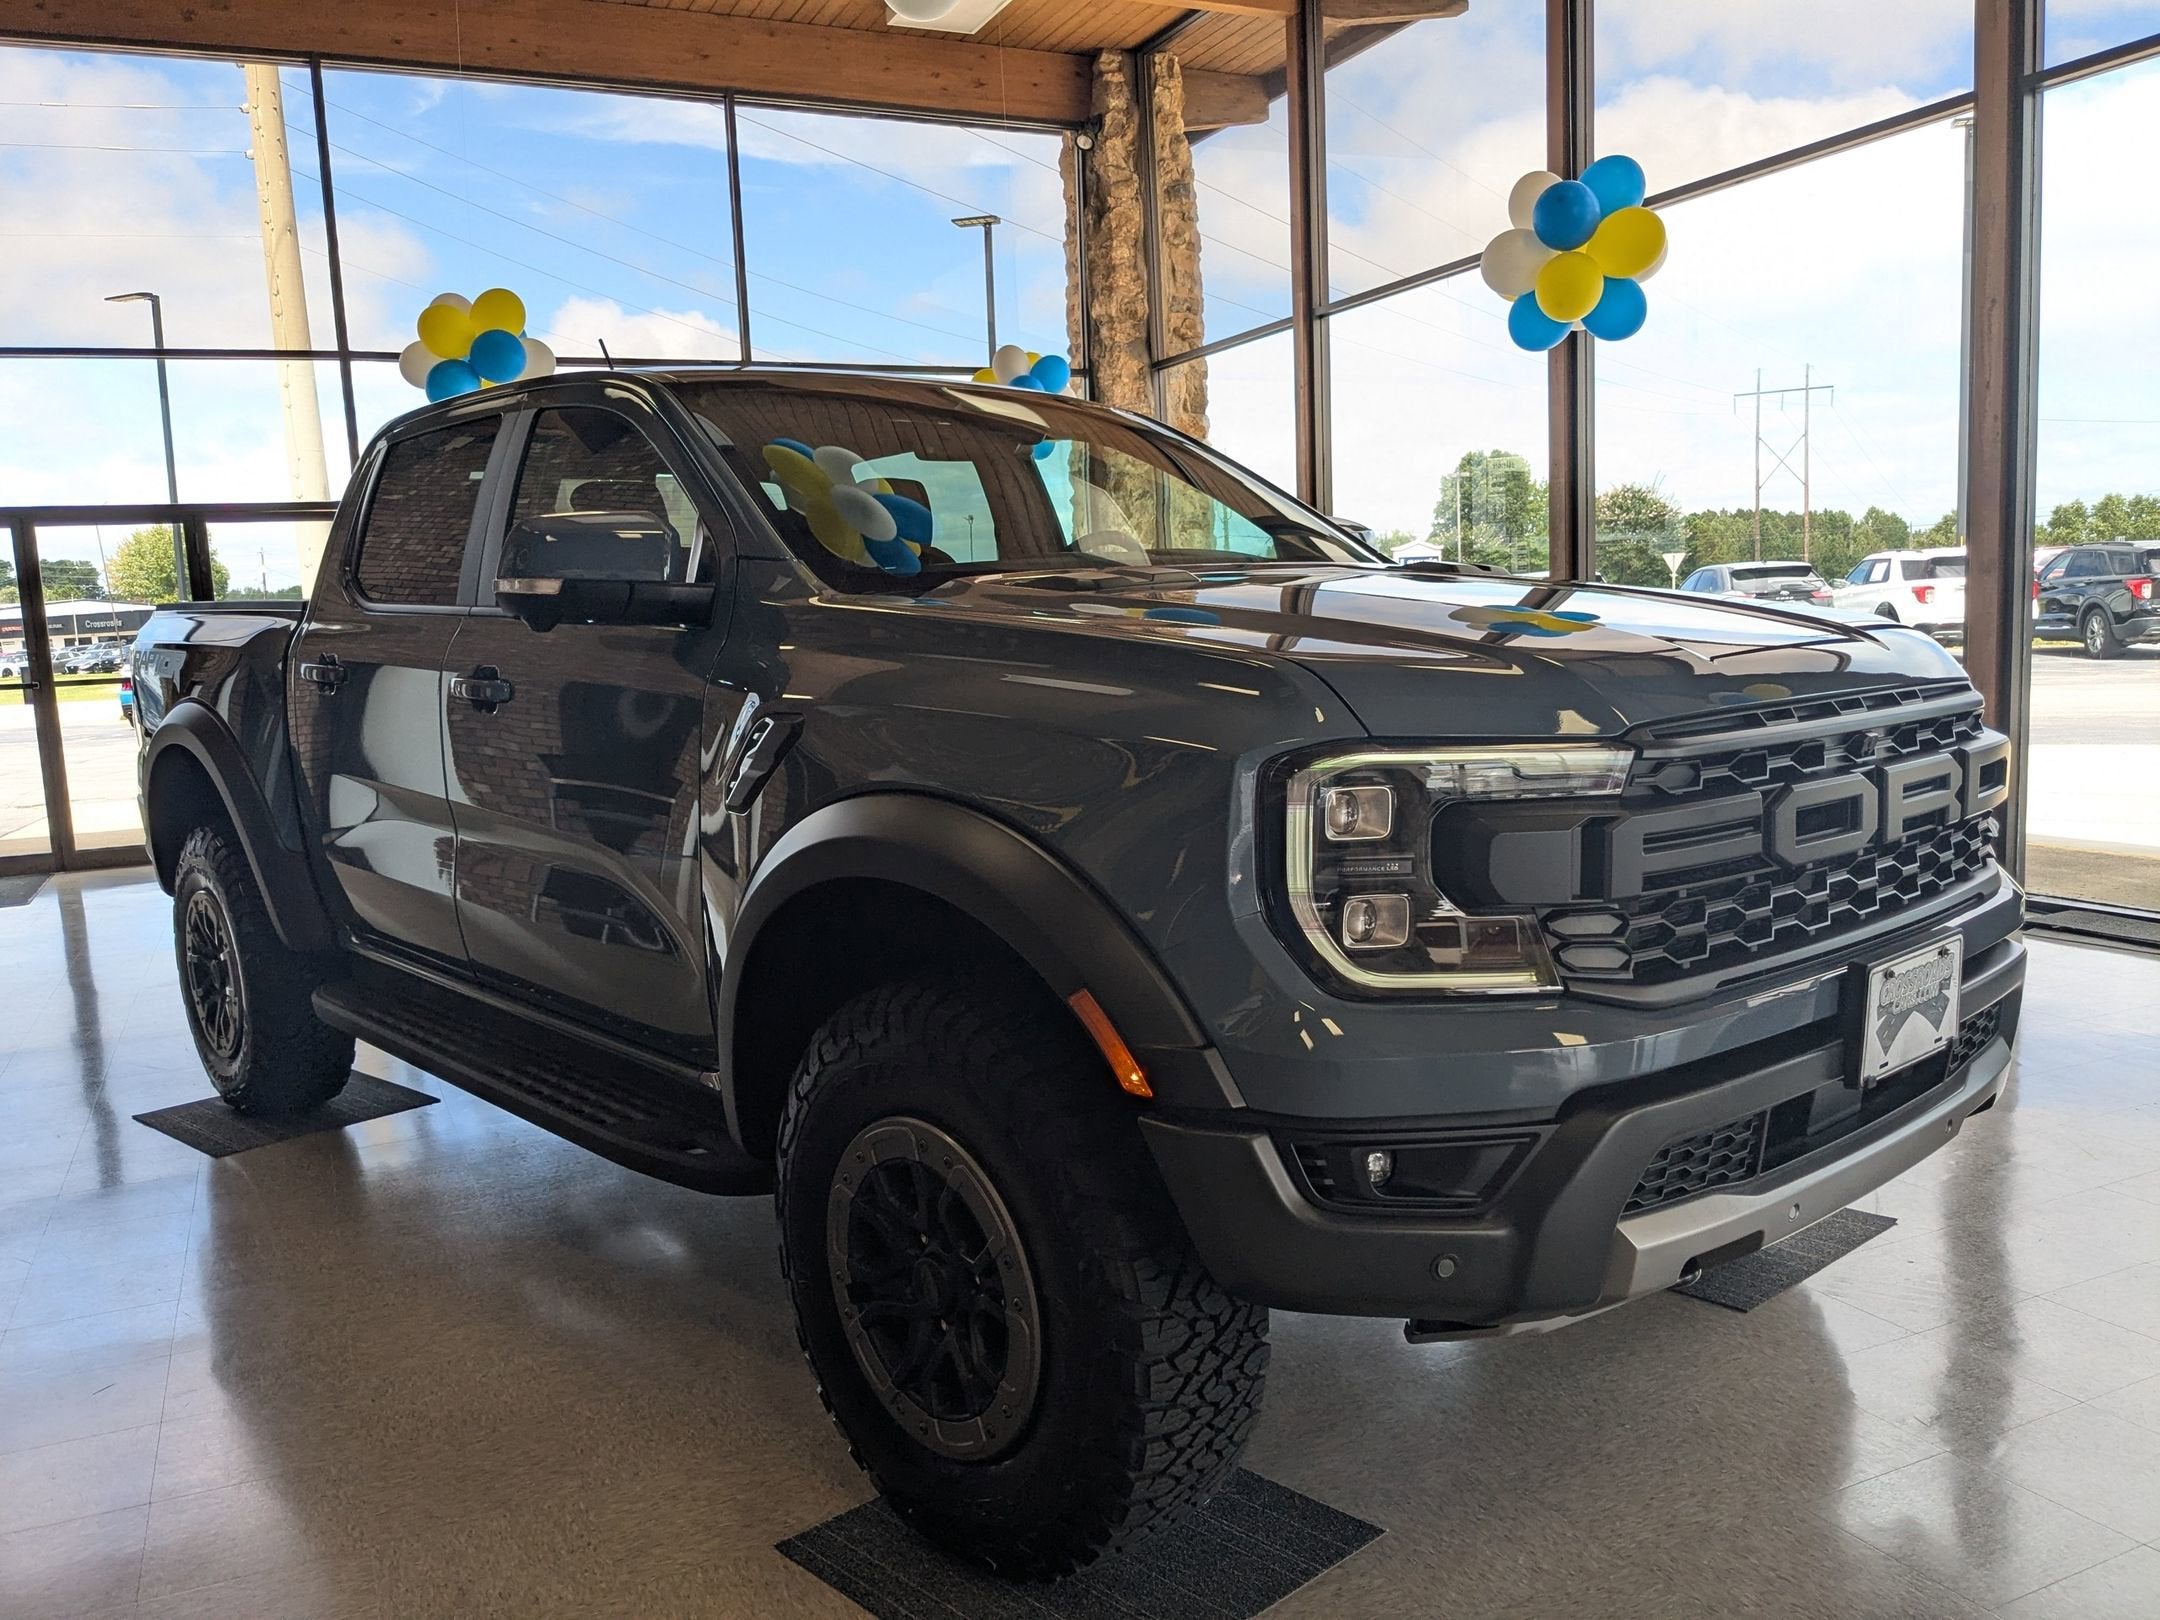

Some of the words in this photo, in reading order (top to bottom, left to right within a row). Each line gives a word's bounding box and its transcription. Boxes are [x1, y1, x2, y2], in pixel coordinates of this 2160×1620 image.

[85, 619, 122, 628] Crossroads
[1611, 733, 2011, 900] FORD
[1880, 952, 1955, 1006] CROSSROADS
